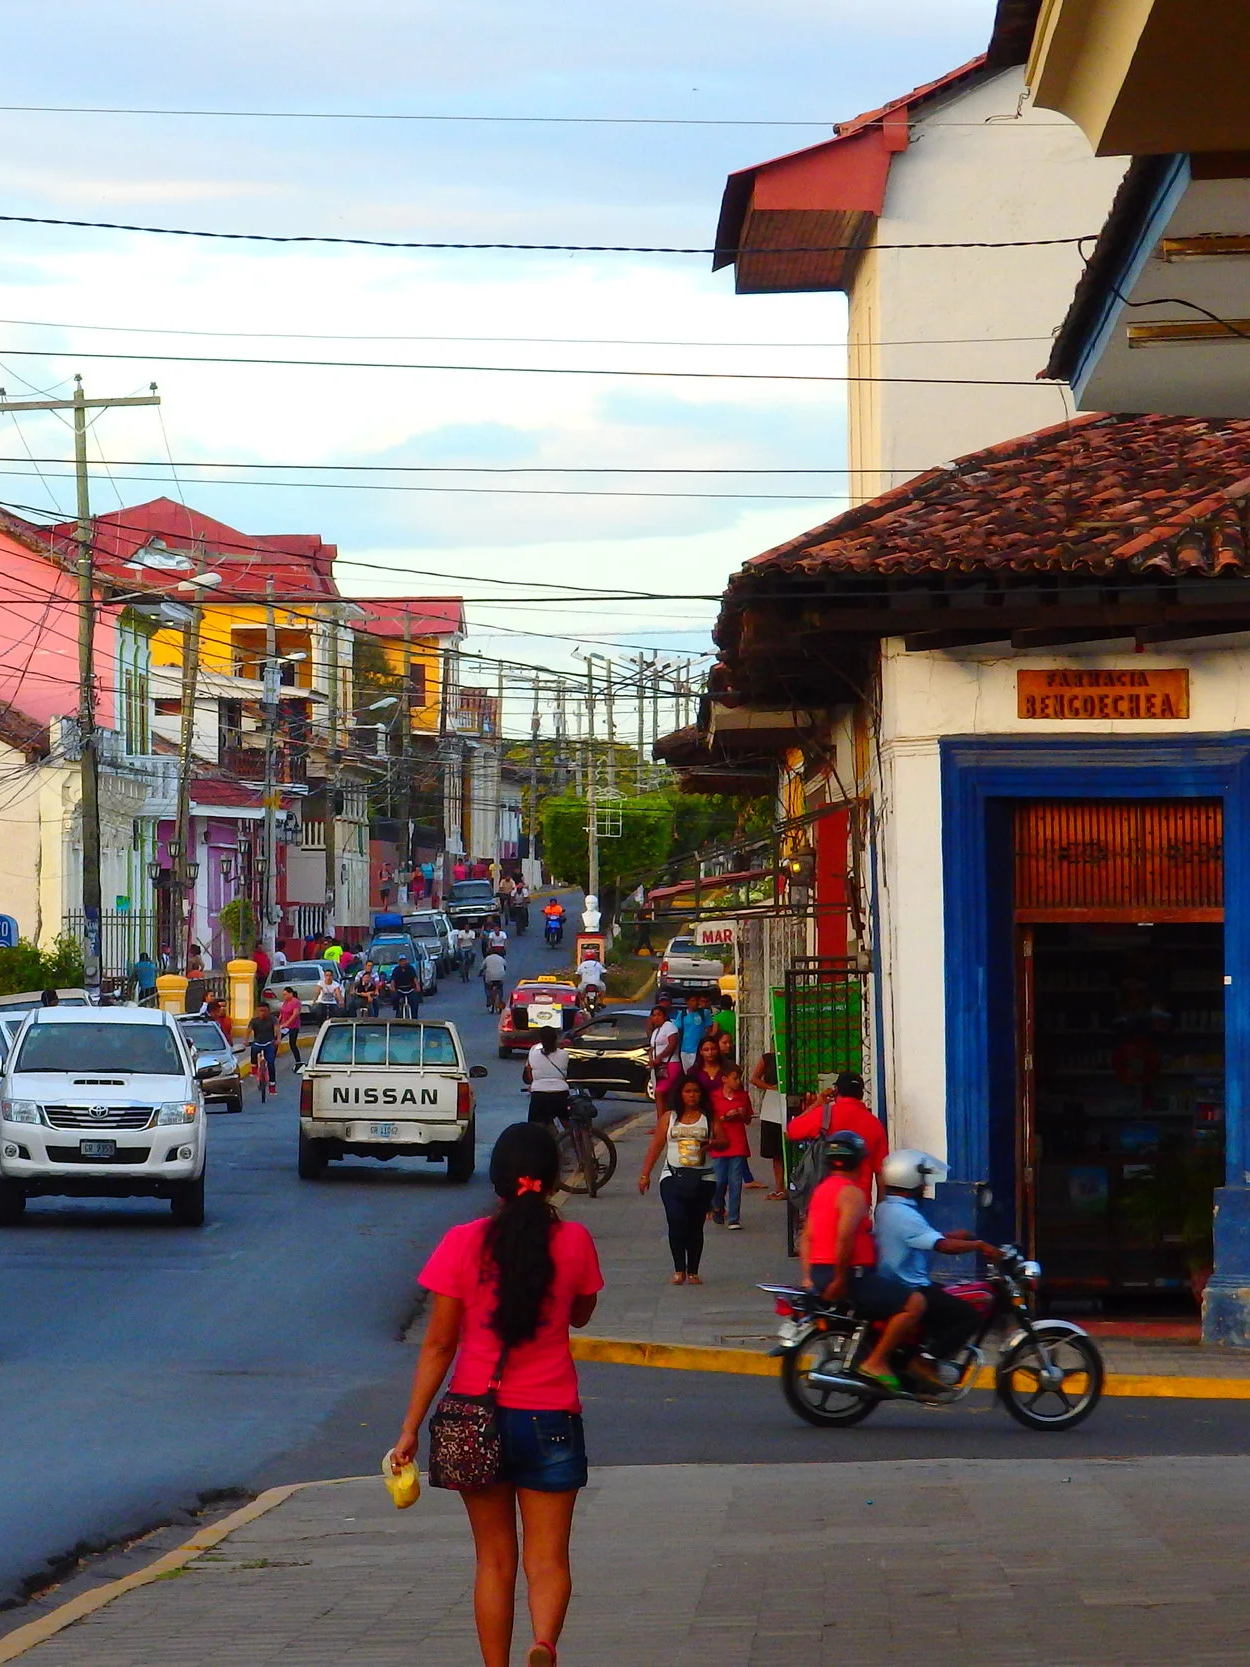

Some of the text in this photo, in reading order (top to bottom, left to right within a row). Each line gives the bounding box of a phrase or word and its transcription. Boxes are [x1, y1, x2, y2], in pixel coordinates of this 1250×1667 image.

[1046, 671, 1149, 688] FARMACIA
[1025, 693, 1175, 718] BENGOECHEA
[702, 929, 733, 943] MAR
[333, 1087, 438, 1105] NISSAN
